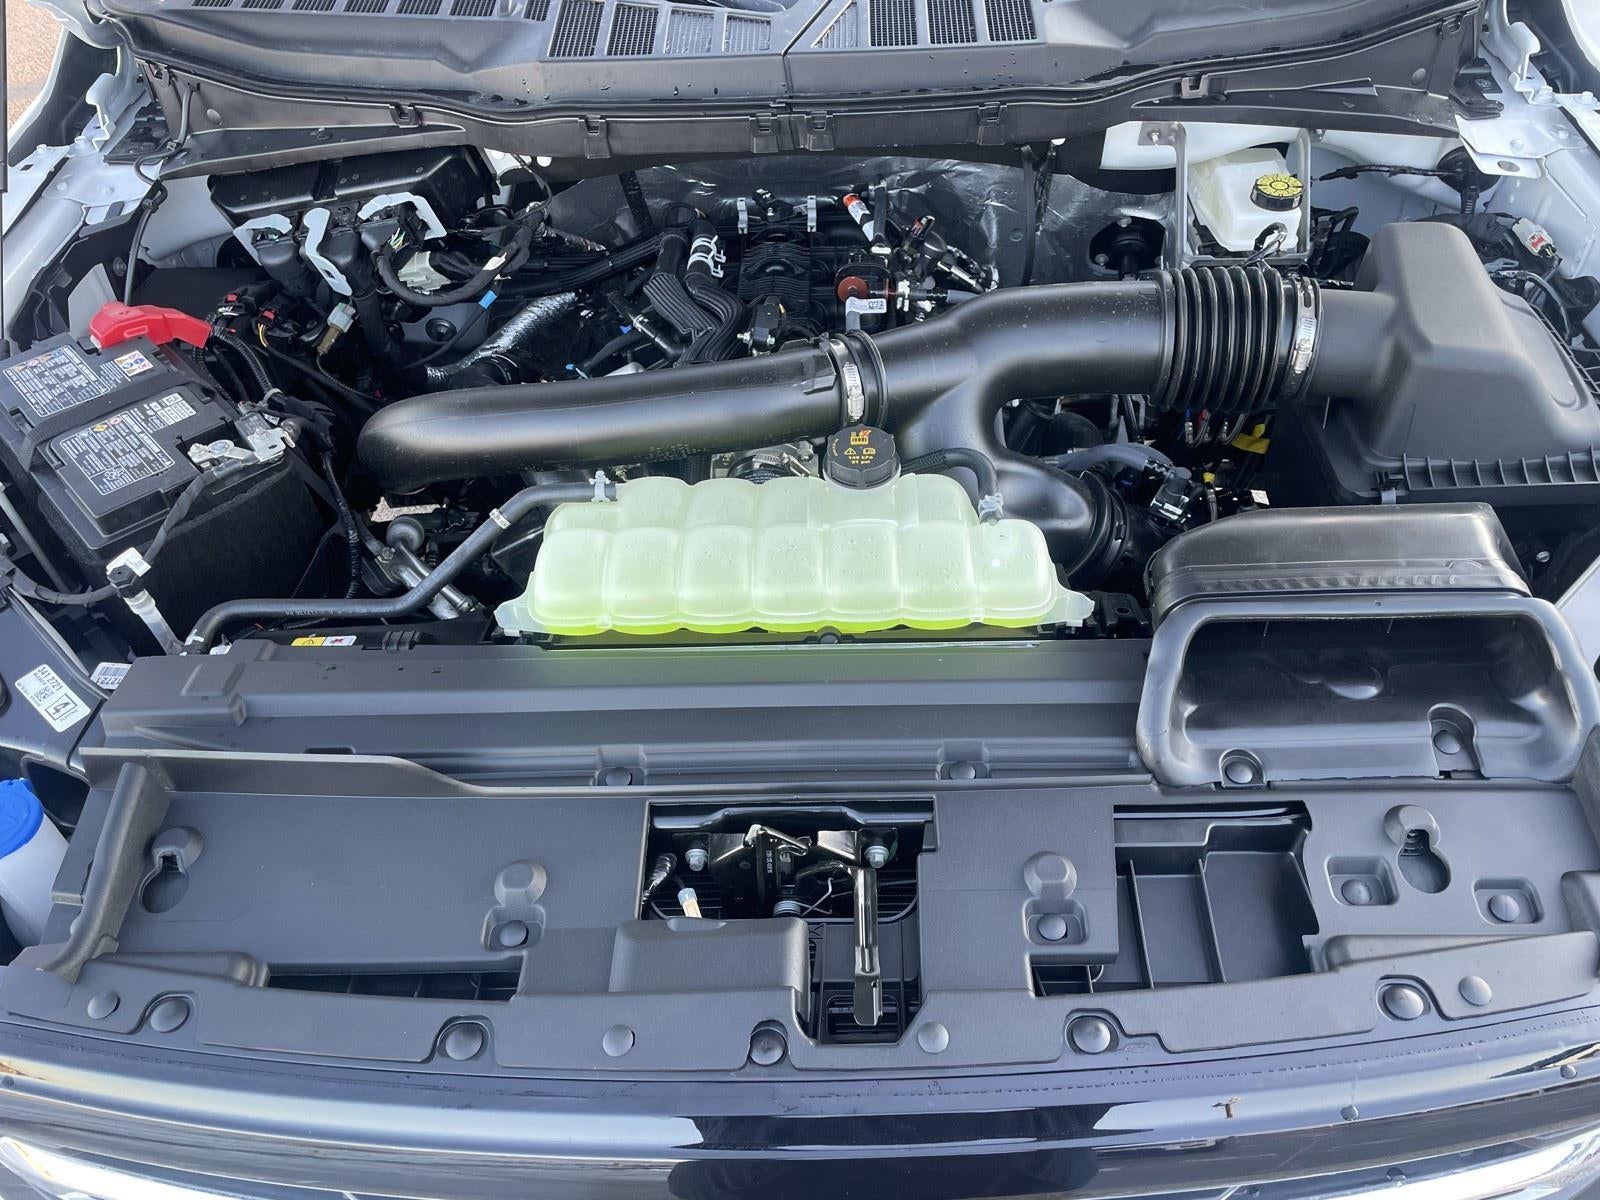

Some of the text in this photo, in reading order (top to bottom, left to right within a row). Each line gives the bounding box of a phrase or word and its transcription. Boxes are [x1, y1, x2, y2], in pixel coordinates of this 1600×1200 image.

[37, 665, 51, 679] 341
[47, 675, 63, 691] 2721
[52, 700, 70, 715] 4
